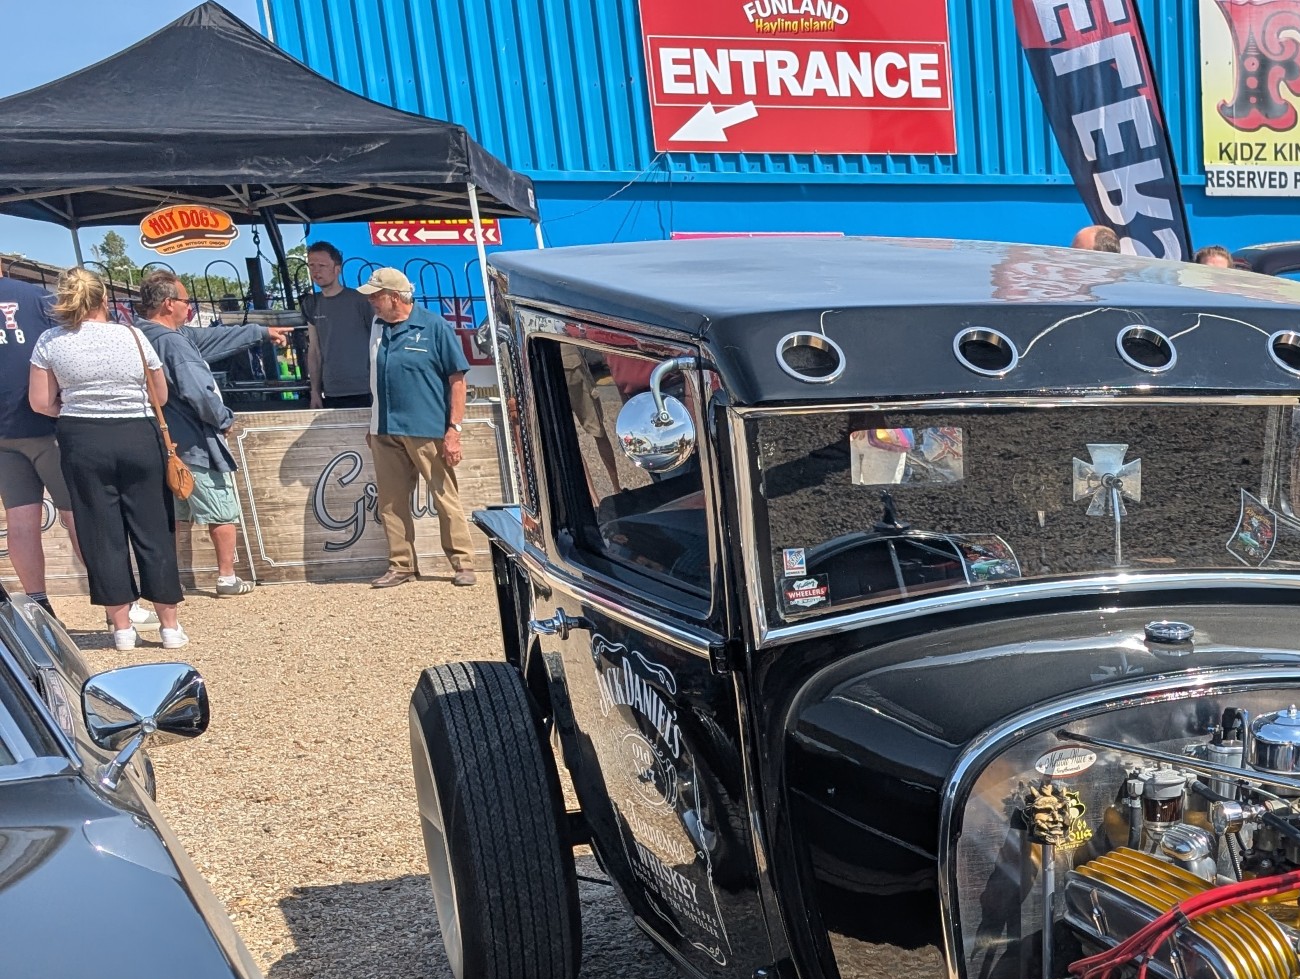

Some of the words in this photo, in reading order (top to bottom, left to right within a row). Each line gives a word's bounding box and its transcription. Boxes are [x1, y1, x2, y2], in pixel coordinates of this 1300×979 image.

[755, 19, 799, 35] Hayling
[800, 18, 835, 33] Island
[658, 47, 943, 100] ENTRANCE
[1218, 142, 1267, 162] KIDZ
[1206, 170, 1289, 189] RESERVED
[148, 211, 179, 236] HOT
[178, 209, 220, 229] DOGS
[788, 588, 825, 599] WHEELERS
[594, 666, 627, 718] JACK
[622, 656, 680, 759] DANIEL'S
[634, 840, 698, 905] WHISKEY
